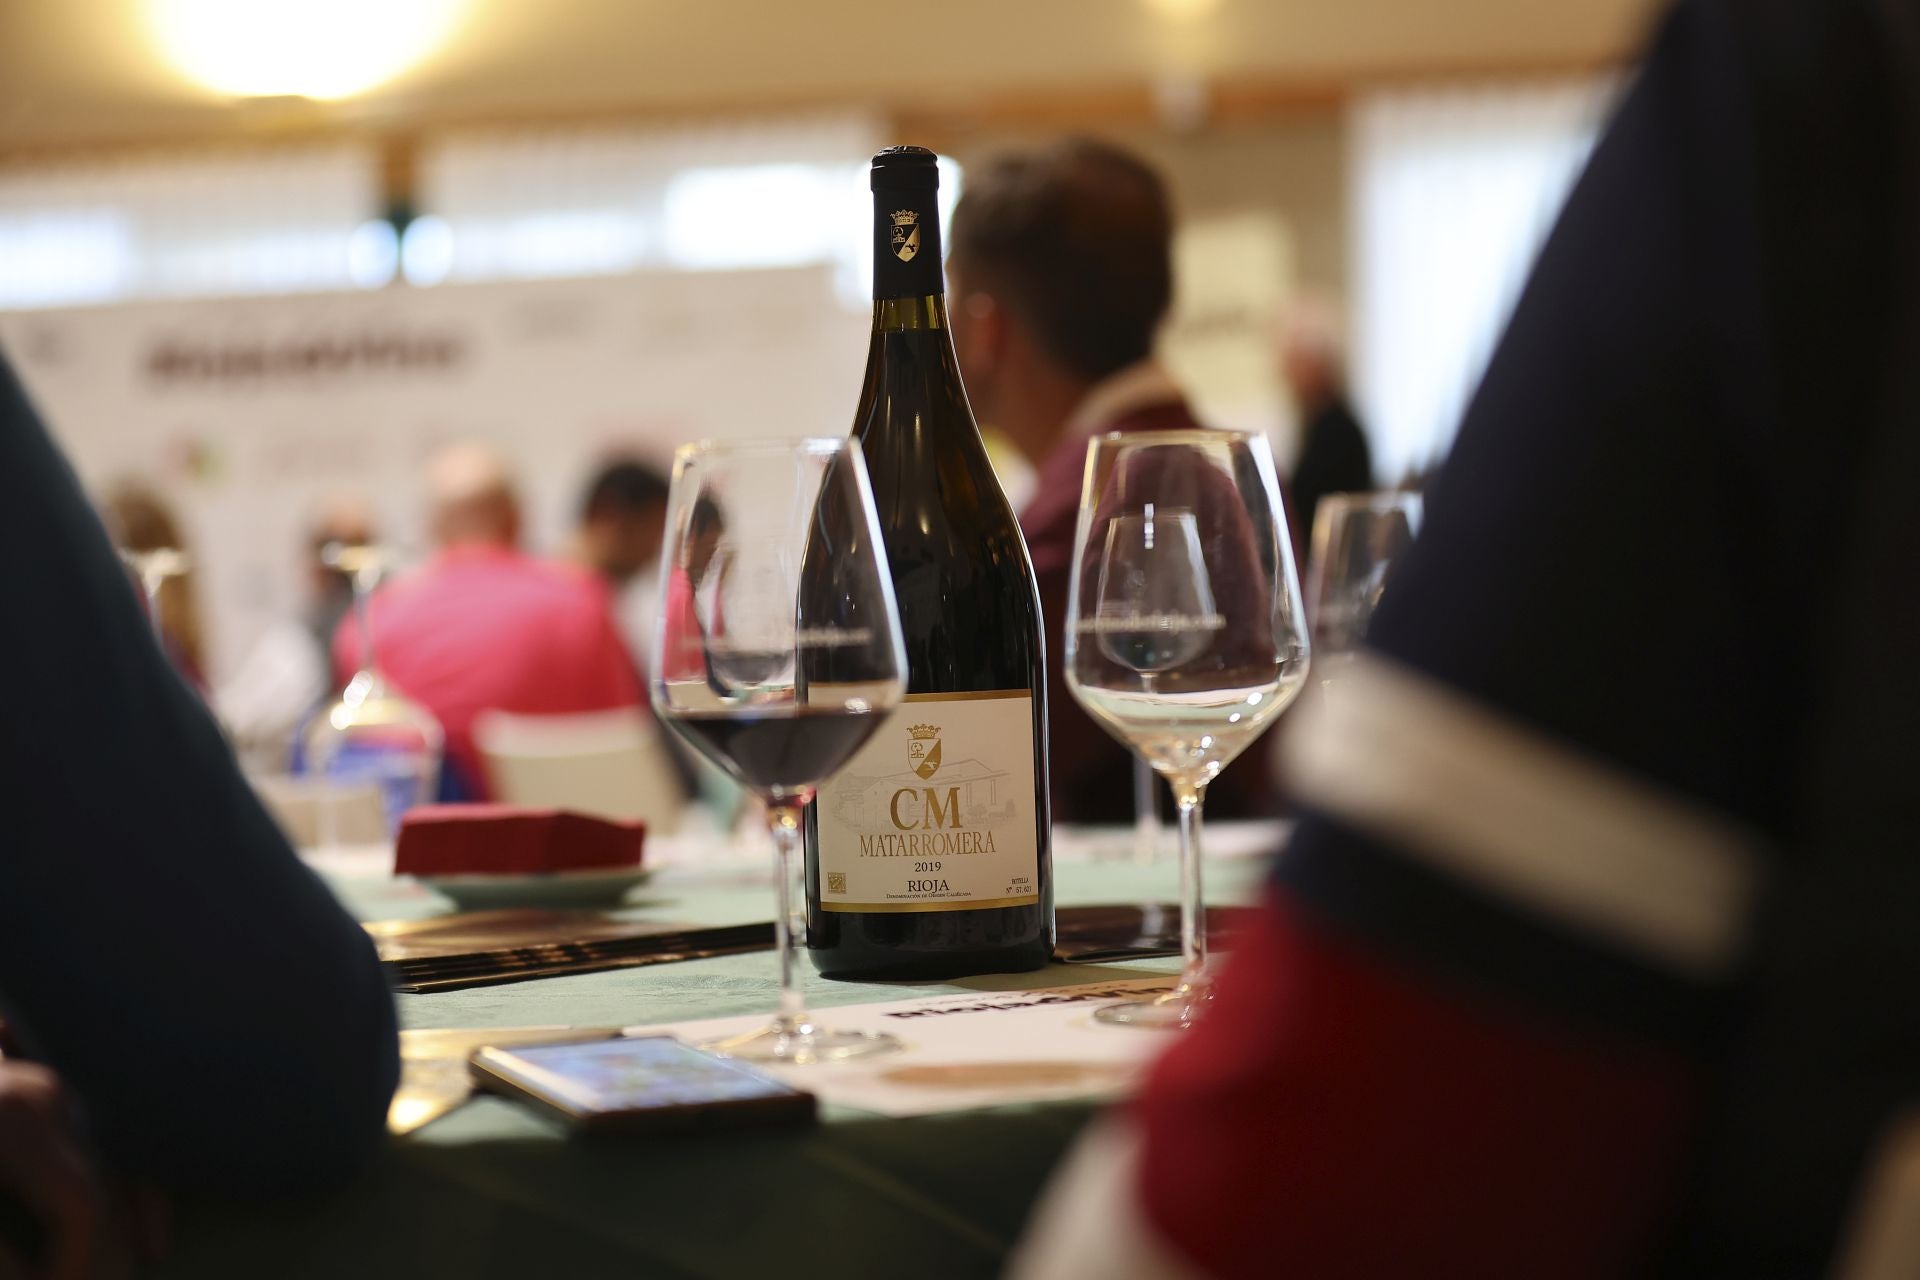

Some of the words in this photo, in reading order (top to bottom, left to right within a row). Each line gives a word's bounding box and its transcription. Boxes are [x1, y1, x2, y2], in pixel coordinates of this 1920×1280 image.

[890, 786, 963, 830] CM
[860, 831, 996, 857] MATARROMERA
[914, 861, 942, 873] 2019
[907, 879, 950, 893] RIOJA
